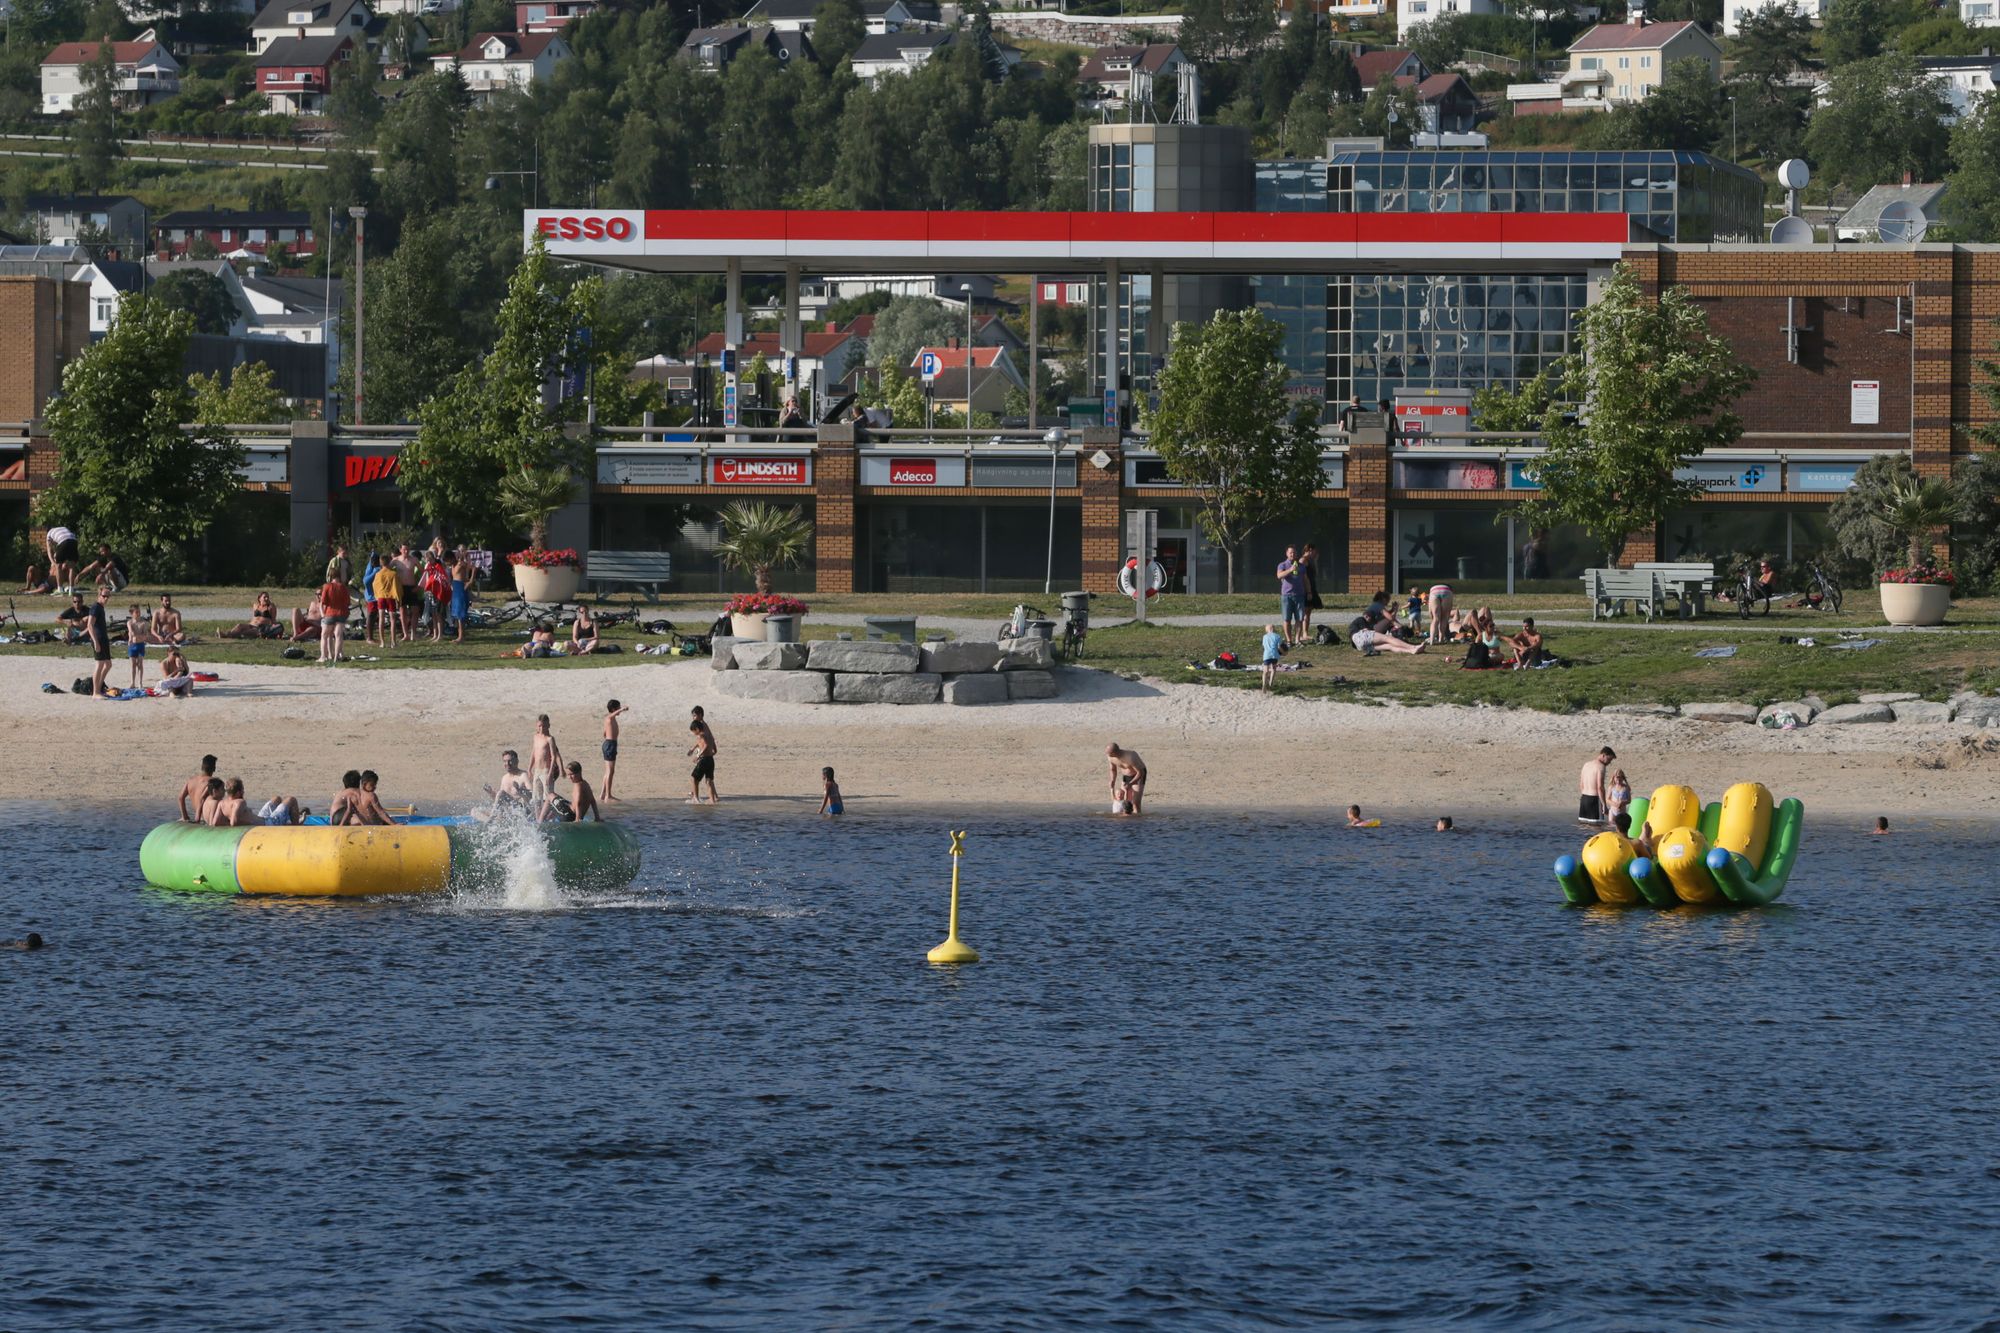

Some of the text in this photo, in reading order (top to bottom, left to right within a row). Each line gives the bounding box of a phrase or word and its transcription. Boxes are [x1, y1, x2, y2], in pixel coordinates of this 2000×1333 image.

[538, 216, 631, 241] ESSO
[925, 356, 932, 372] P
[1406, 407, 1421, 415] AGA
[1442, 407, 1458, 416] AGA
[738, 462, 797, 475] LINDSETH
[893, 471, 933, 482] Adecco
[1808, 473, 1847, 481] kantega
